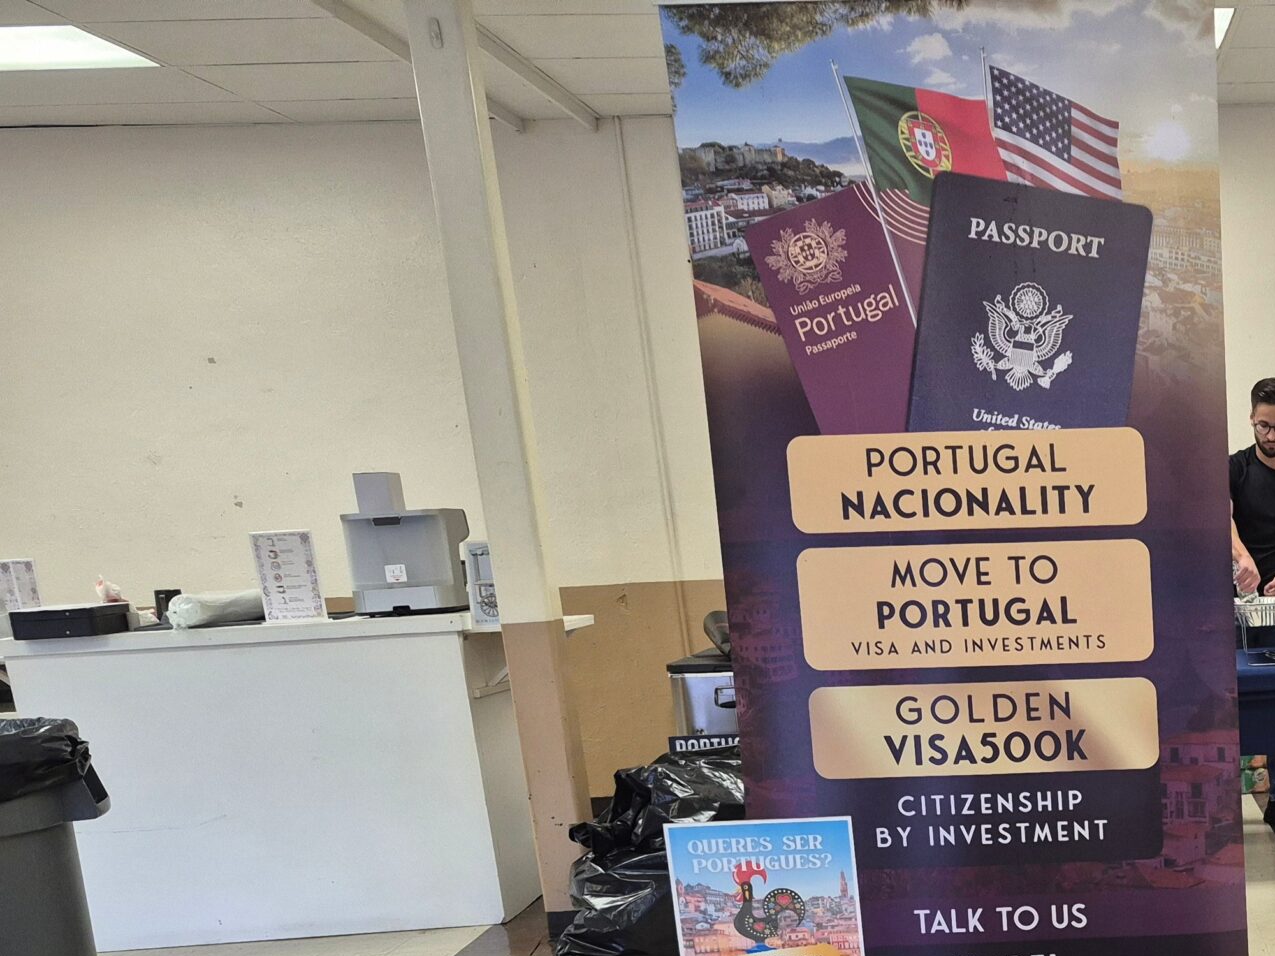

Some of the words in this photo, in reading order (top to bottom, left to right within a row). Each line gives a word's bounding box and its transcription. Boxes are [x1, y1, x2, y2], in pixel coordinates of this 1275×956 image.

[968, 217, 1105, 258] PASSPORT
[789, 298, 819, 316] União
[819, 283, 862, 306] Europeia
[794, 284, 900, 342] Portugal
[805, 330, 858, 356] Passaporte
[972, 408, 1019, 427] United
[1020, 416, 1062, 430] States
[865, 443, 1067, 477] PORTUGAL
[841, 484, 1096, 521] NACIONALITY
[890, 556, 992, 588] MOVE
[1007, 554, 1060, 585] TO
[875, 595, 1078, 630] PORTUGAL
[851, 639, 899, 656] VISA
[911, 638, 953, 655] AND
[964, 634, 1107, 653] INVESTMENTS
[895, 691, 1072, 725] GOLDEN
[883, 729, 1088, 766] VISA500K
[897, 789, 1083, 816] CITIZENSHIP
[687, 836, 772, 856] QUERES
[782, 834, 823, 850] SER
[875, 826, 913, 848] BY
[929, 819, 1108, 845] INVESTMENT
[692, 853, 833, 874] PORTUGUES?
[914, 907, 985, 934] TALK
[996, 905, 1040, 931] TO
[1051, 903, 1088, 929] US
